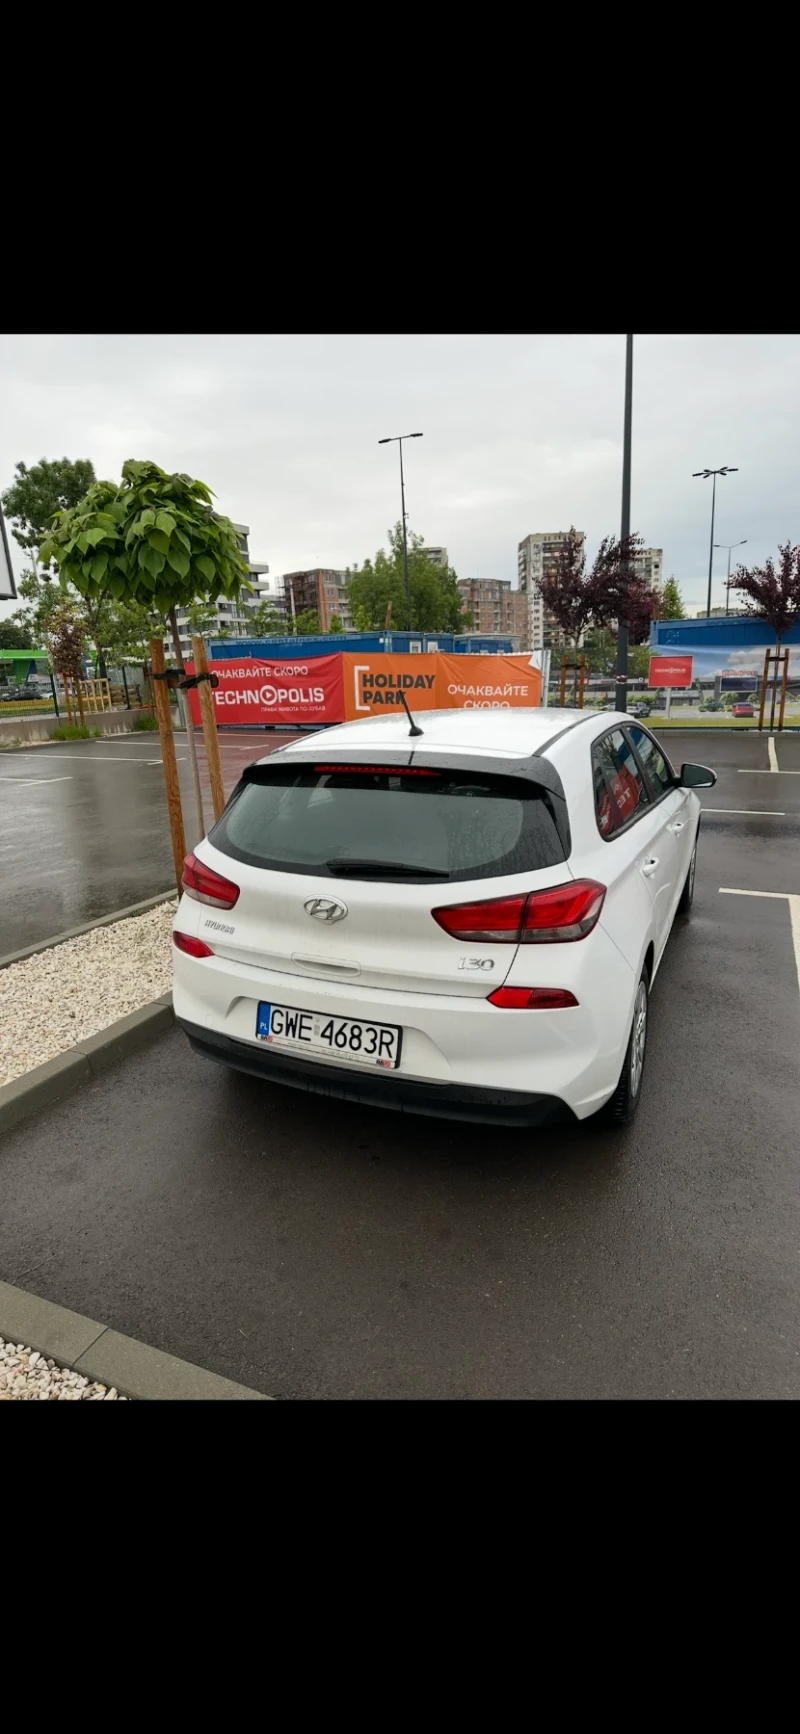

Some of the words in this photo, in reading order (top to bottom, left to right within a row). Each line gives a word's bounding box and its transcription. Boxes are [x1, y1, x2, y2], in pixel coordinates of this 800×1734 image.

[273, 665, 309, 677] СКОРО
[362, 673, 436, 689] HOLIDAY
[211, 685, 325, 706] ECHNOPOLIS
[363, 690, 407, 705] PARK
[447, 683, 529, 697] ОЧАКВАЙТЕ
[260, 1022, 268, 1031] PL
[270, 1009, 313, 1042] GWE
[320, 1019, 395, 1058] 4683R
